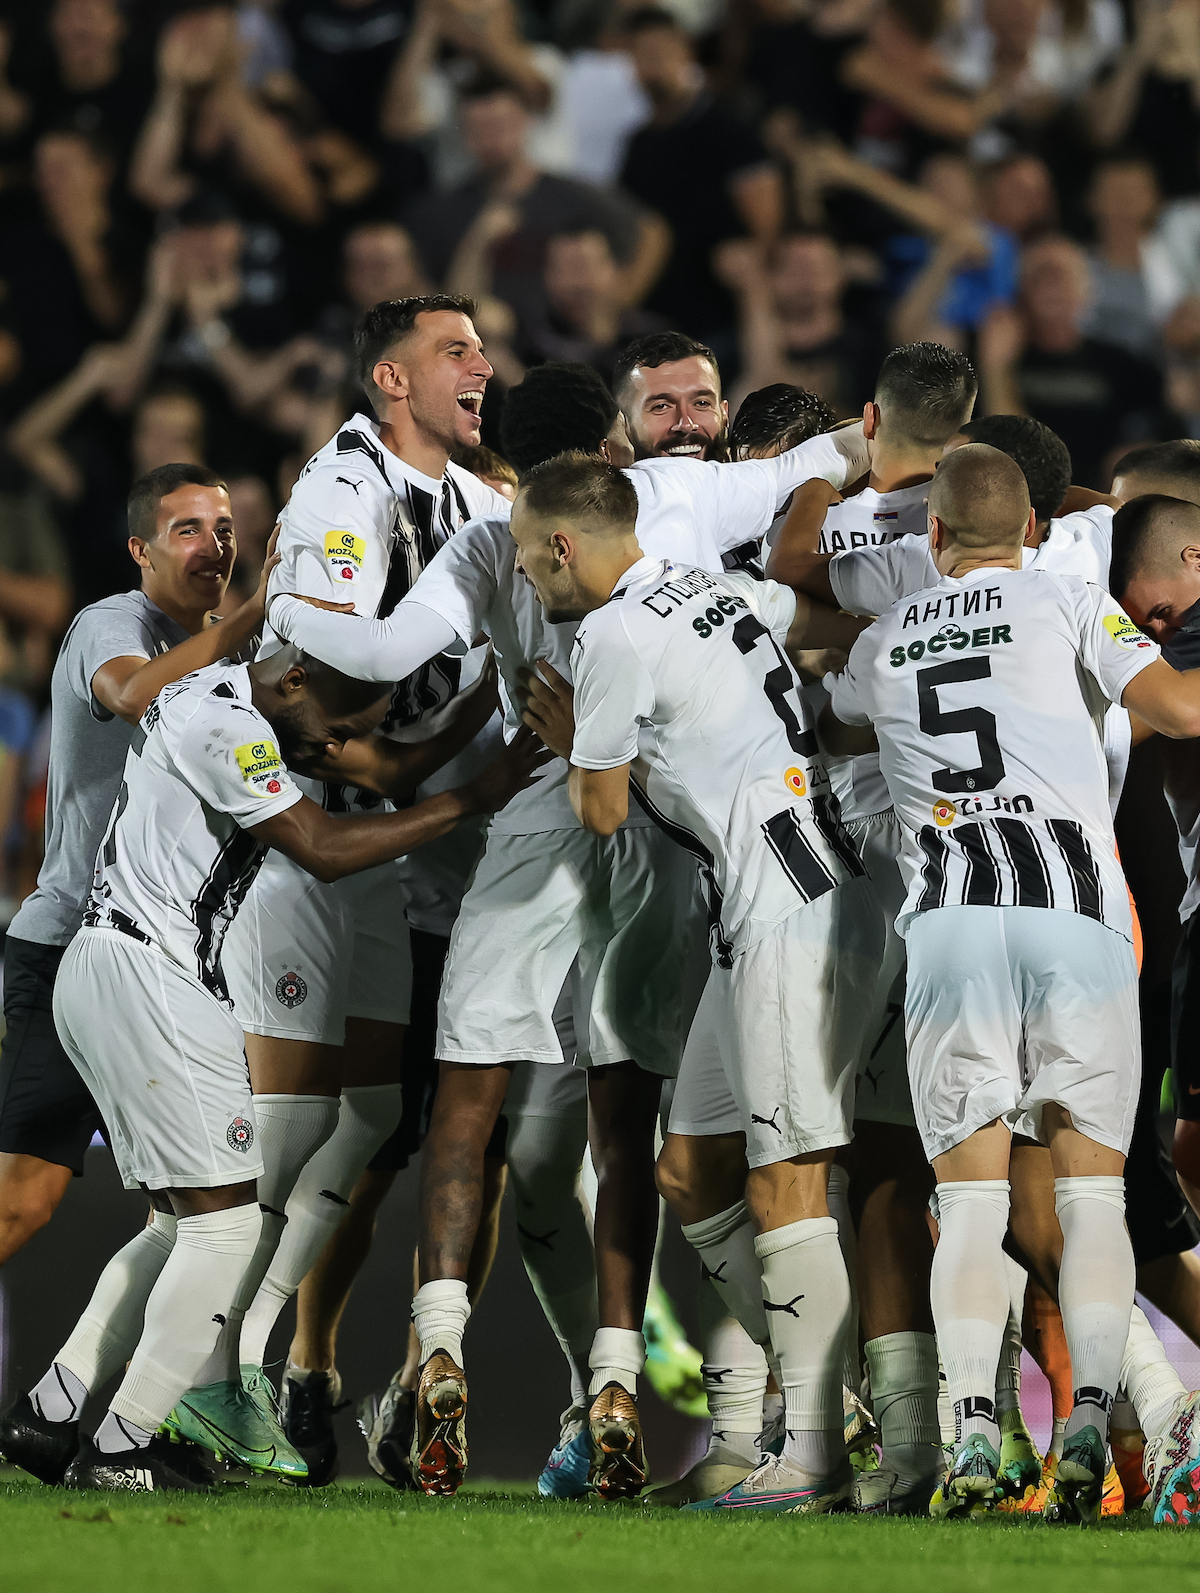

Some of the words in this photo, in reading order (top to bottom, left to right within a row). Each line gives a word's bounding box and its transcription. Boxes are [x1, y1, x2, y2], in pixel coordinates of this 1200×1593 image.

[889, 624, 1014, 668] SOCCER
[902, 586, 1002, 630] АНТИЋ
[732, 613, 820, 758] 2
[916, 655, 1007, 794] 5
